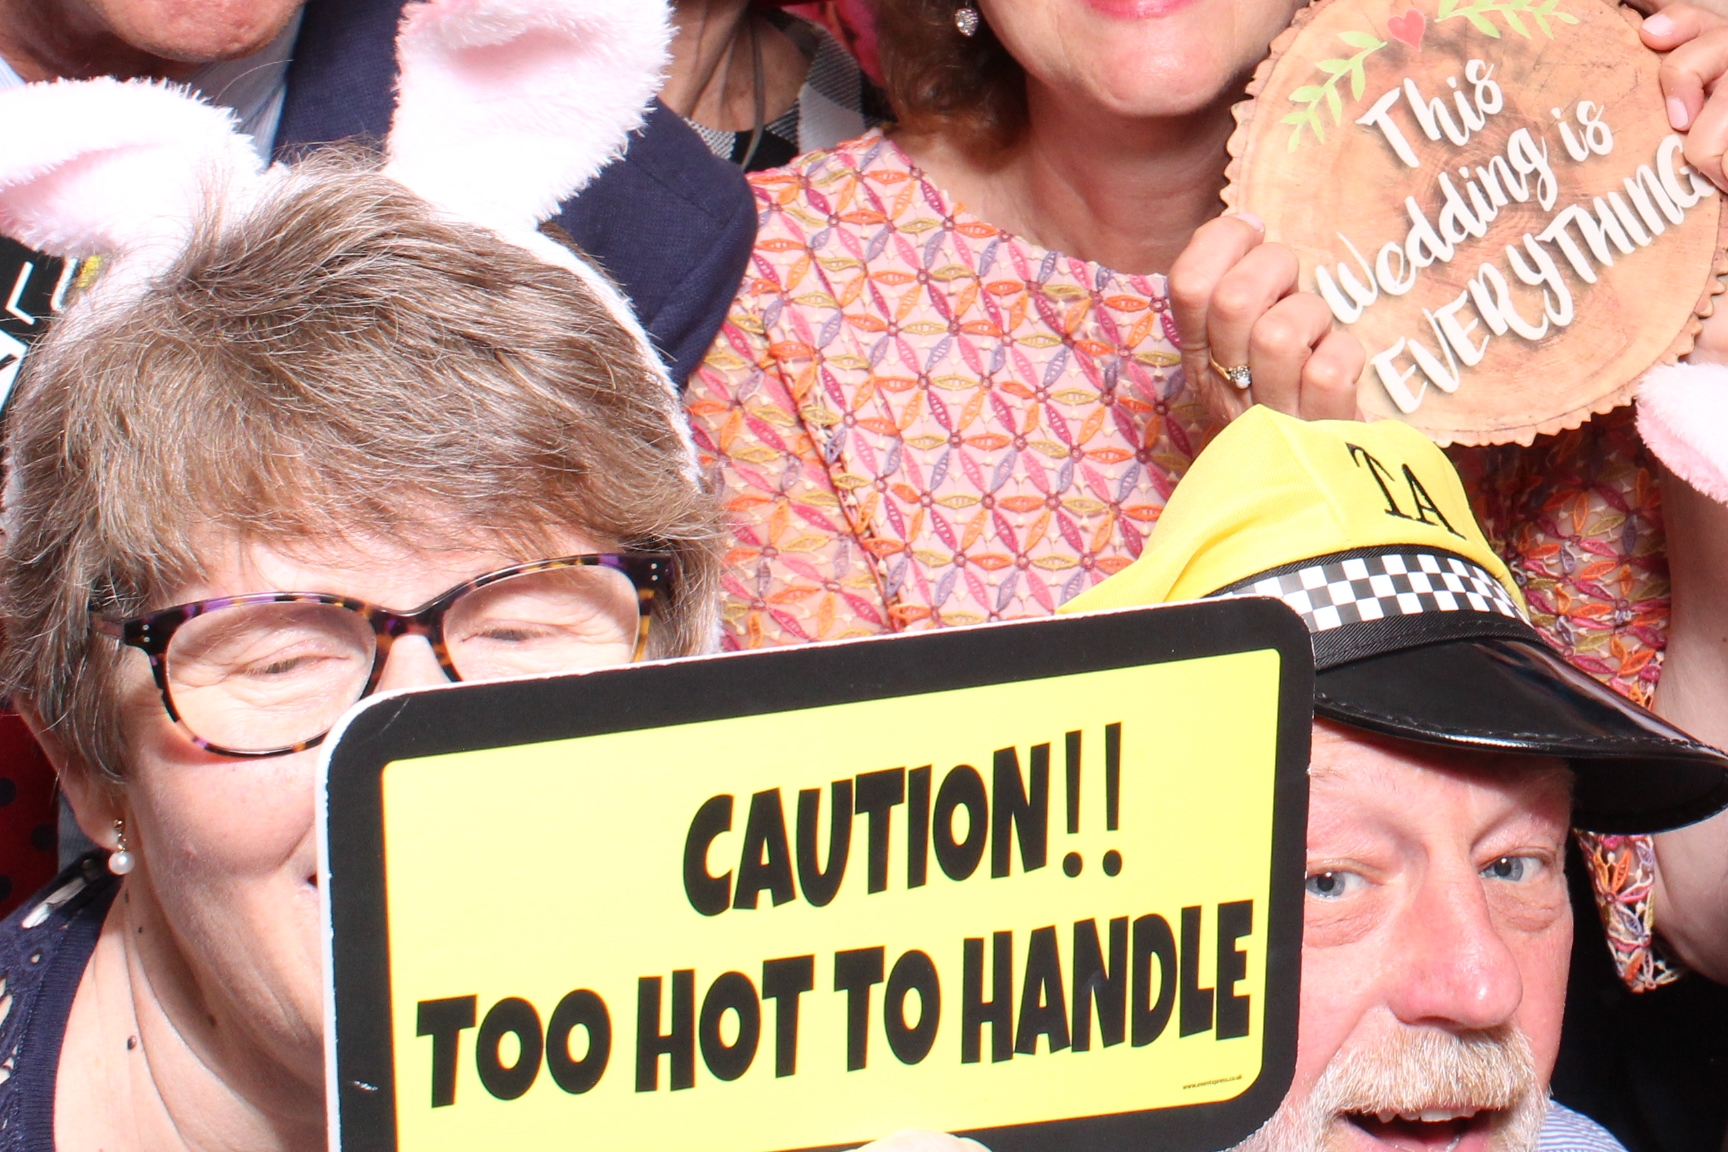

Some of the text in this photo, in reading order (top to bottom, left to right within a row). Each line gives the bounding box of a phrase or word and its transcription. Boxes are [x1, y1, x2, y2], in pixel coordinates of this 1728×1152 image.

[1315, 99, 1615, 325] Wedding is
[1355, 59, 1504, 168] This
[1370, 133, 1717, 415] EVERYTHING
[682, 721, 1124, 917] CAUTION!!
[415, 898, 1255, 1109] TOO HOT TO HANDLE
